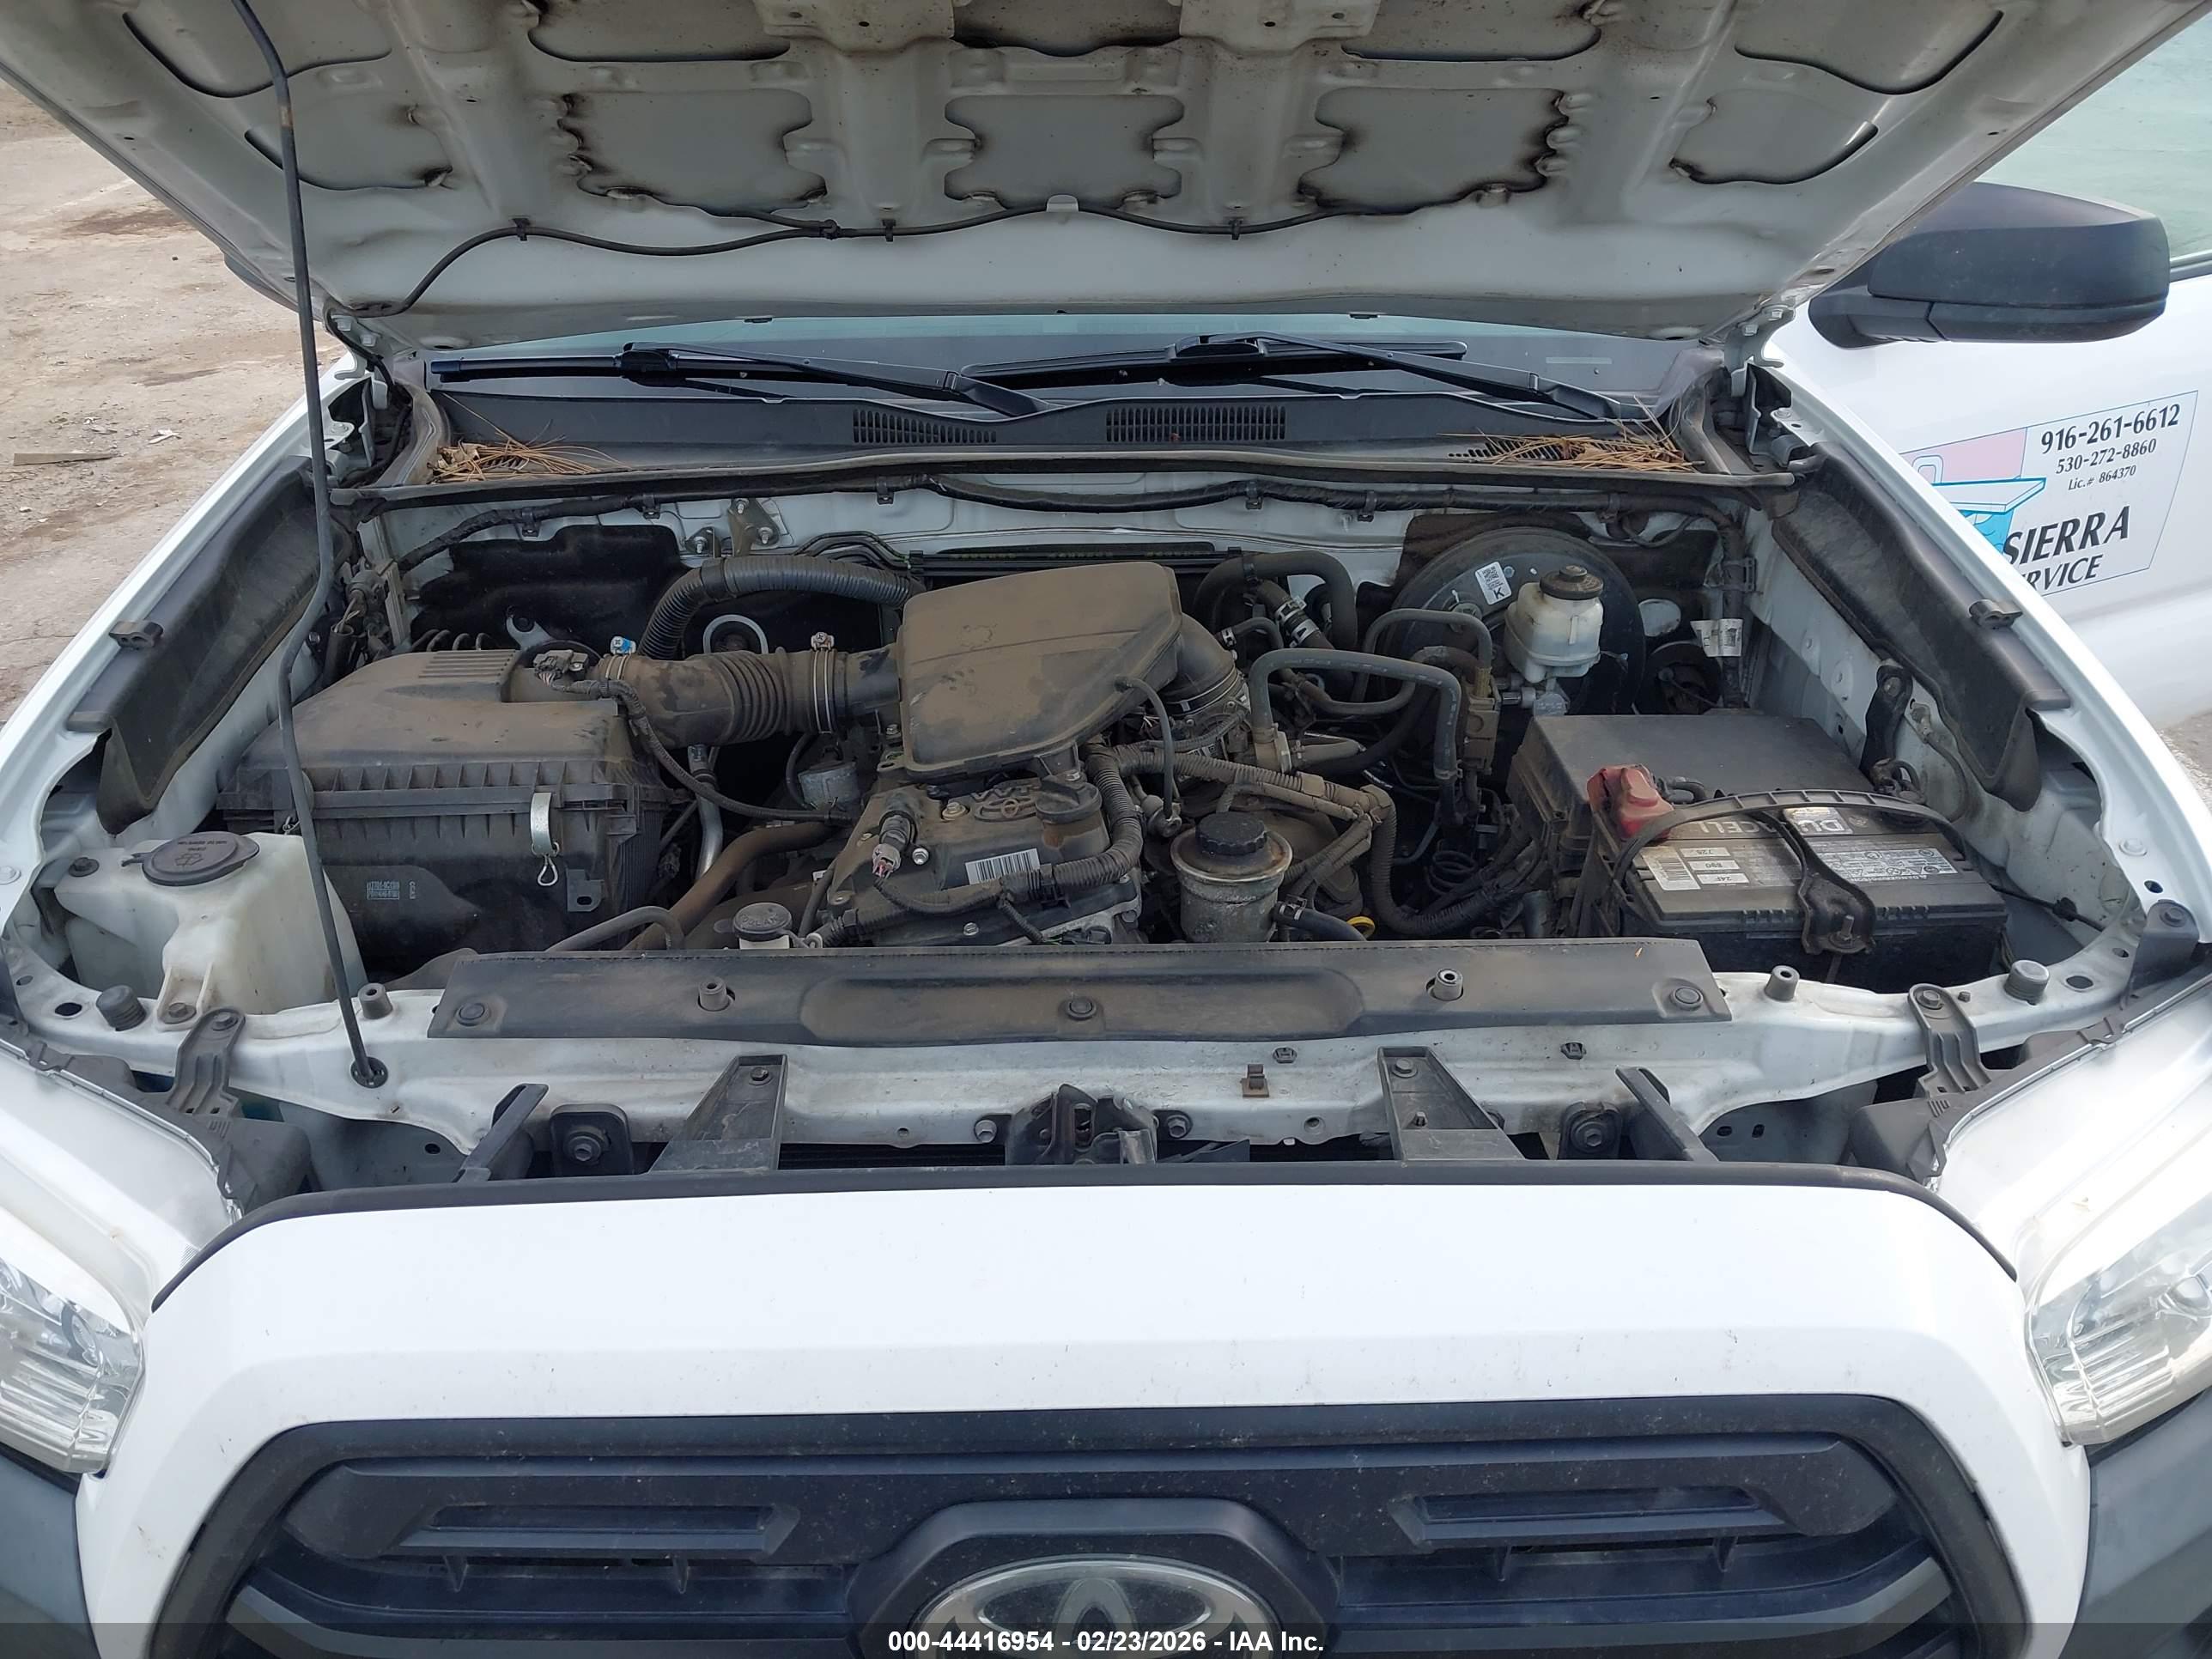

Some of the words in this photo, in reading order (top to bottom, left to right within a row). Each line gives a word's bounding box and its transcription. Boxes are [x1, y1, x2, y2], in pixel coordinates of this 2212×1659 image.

[2041, 404, 2181, 454] 916-261-6612
[2056, 438, 2157, 474] 530-272-8860
[2099, 465, 2136, 483] 864370
[2003, 505, 2130, 565] SIERRA
[2021, 554, 2103, 591] RVICE
[1493, 586, 1505, 599] K
